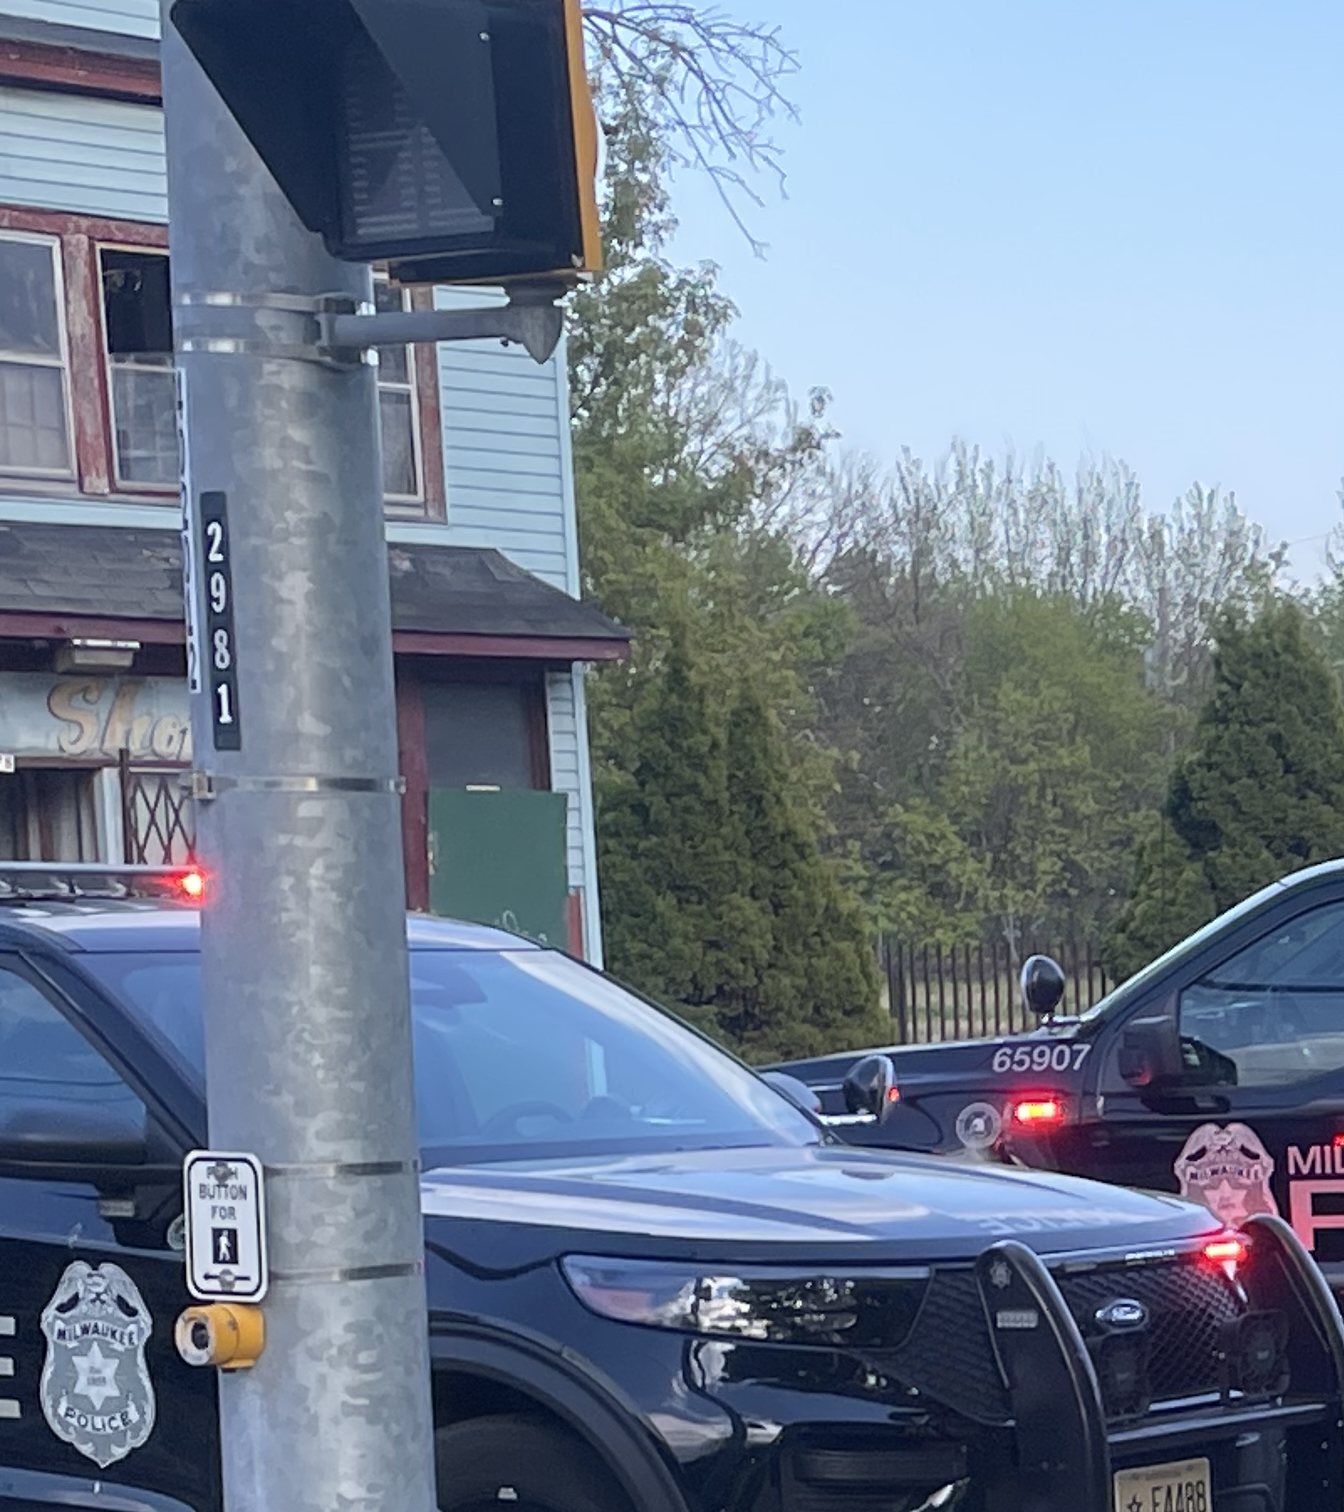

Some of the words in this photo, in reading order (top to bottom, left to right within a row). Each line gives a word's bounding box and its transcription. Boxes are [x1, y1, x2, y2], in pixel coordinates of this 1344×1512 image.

[207, 521, 233, 724] 2981
[47, 678, 192, 760] Sho
[992, 1043, 1092, 1073] 65907
[199, 1183, 248, 1201] BUTTON
[211, 1205, 237, 1221] FOR
[56, 1321, 136, 1348] MILWAUKEE
[64, 1407, 133, 1432] POLICE
